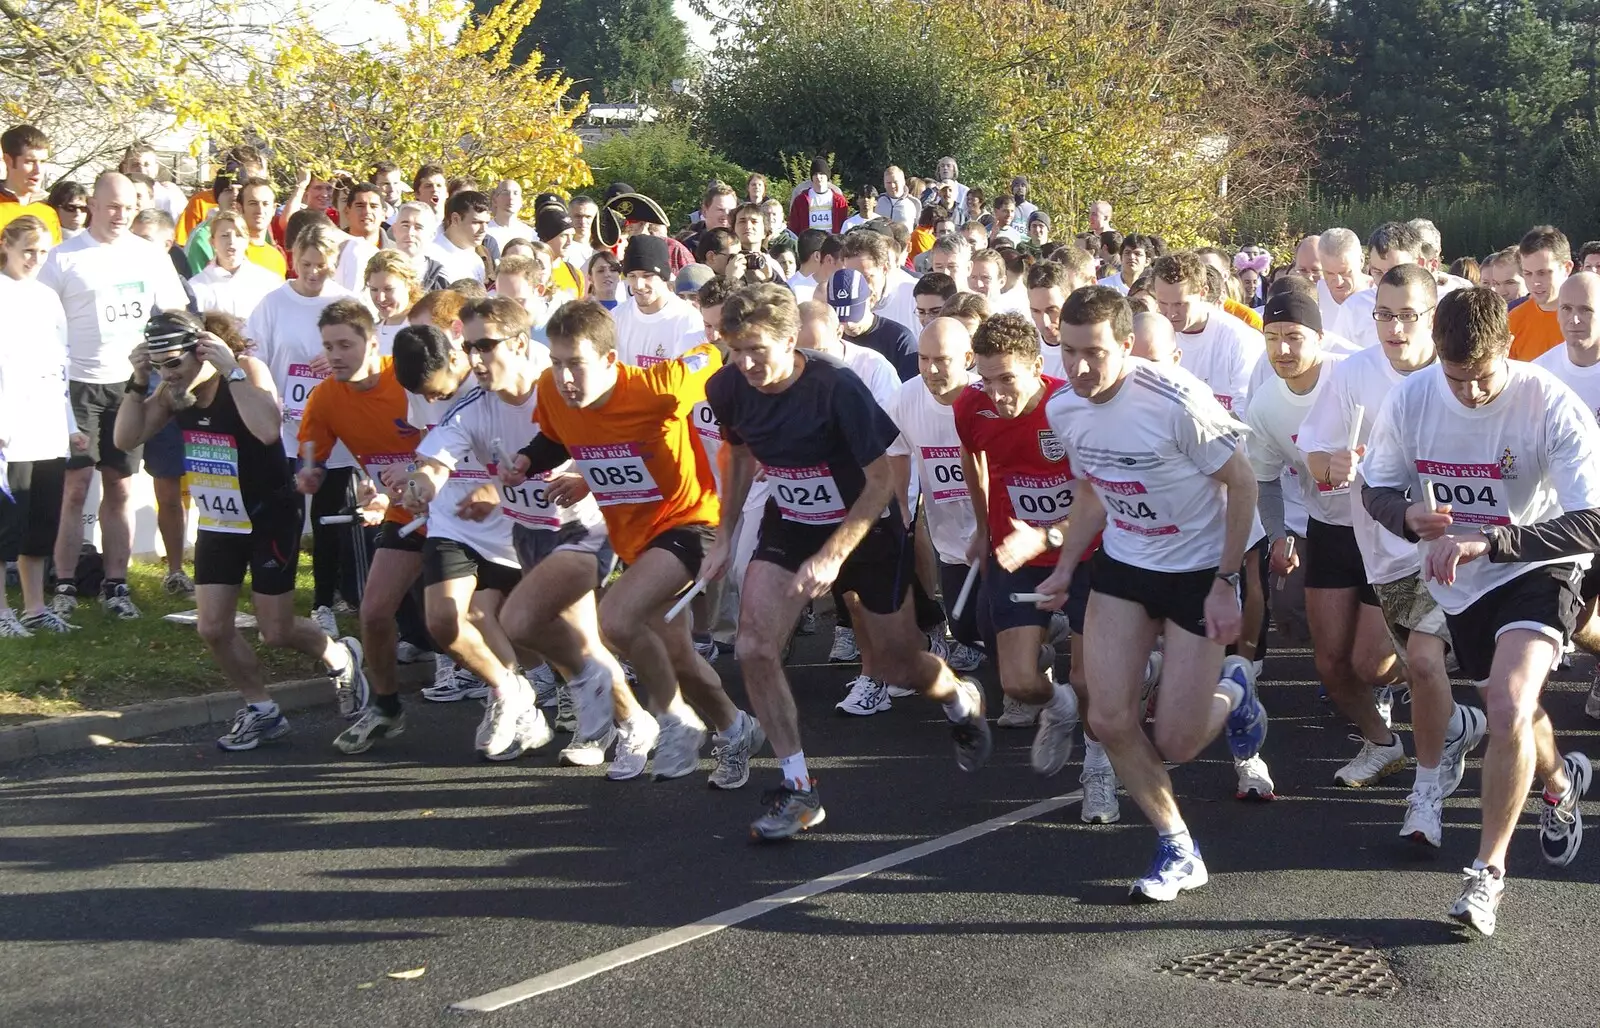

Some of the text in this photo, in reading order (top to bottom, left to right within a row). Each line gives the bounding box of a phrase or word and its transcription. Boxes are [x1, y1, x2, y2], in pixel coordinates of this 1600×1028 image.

[811, 214, 829, 222] 044
[106, 301, 143, 322] 043
[212, 439, 230, 447] RUN
[213, 452, 231, 460] RUN
[581, 449, 632, 459] FUN RUN
[192, 465, 231, 475] FUN RUN
[589, 465, 643, 486] 085
[796, 470, 822, 478] RUN
[935, 465, 965, 483] 06
[1427, 467, 1456, 477] FUN
[1461, 469, 1491, 477] RUN
[1014, 475, 1067, 488] FUN RUN
[778, 484, 832, 505] 024
[1019, 489, 1074, 513] 003
[1433, 483, 1497, 507] 004
[199, 494, 239, 515] 144
[1104, 495, 1157, 520] 034
